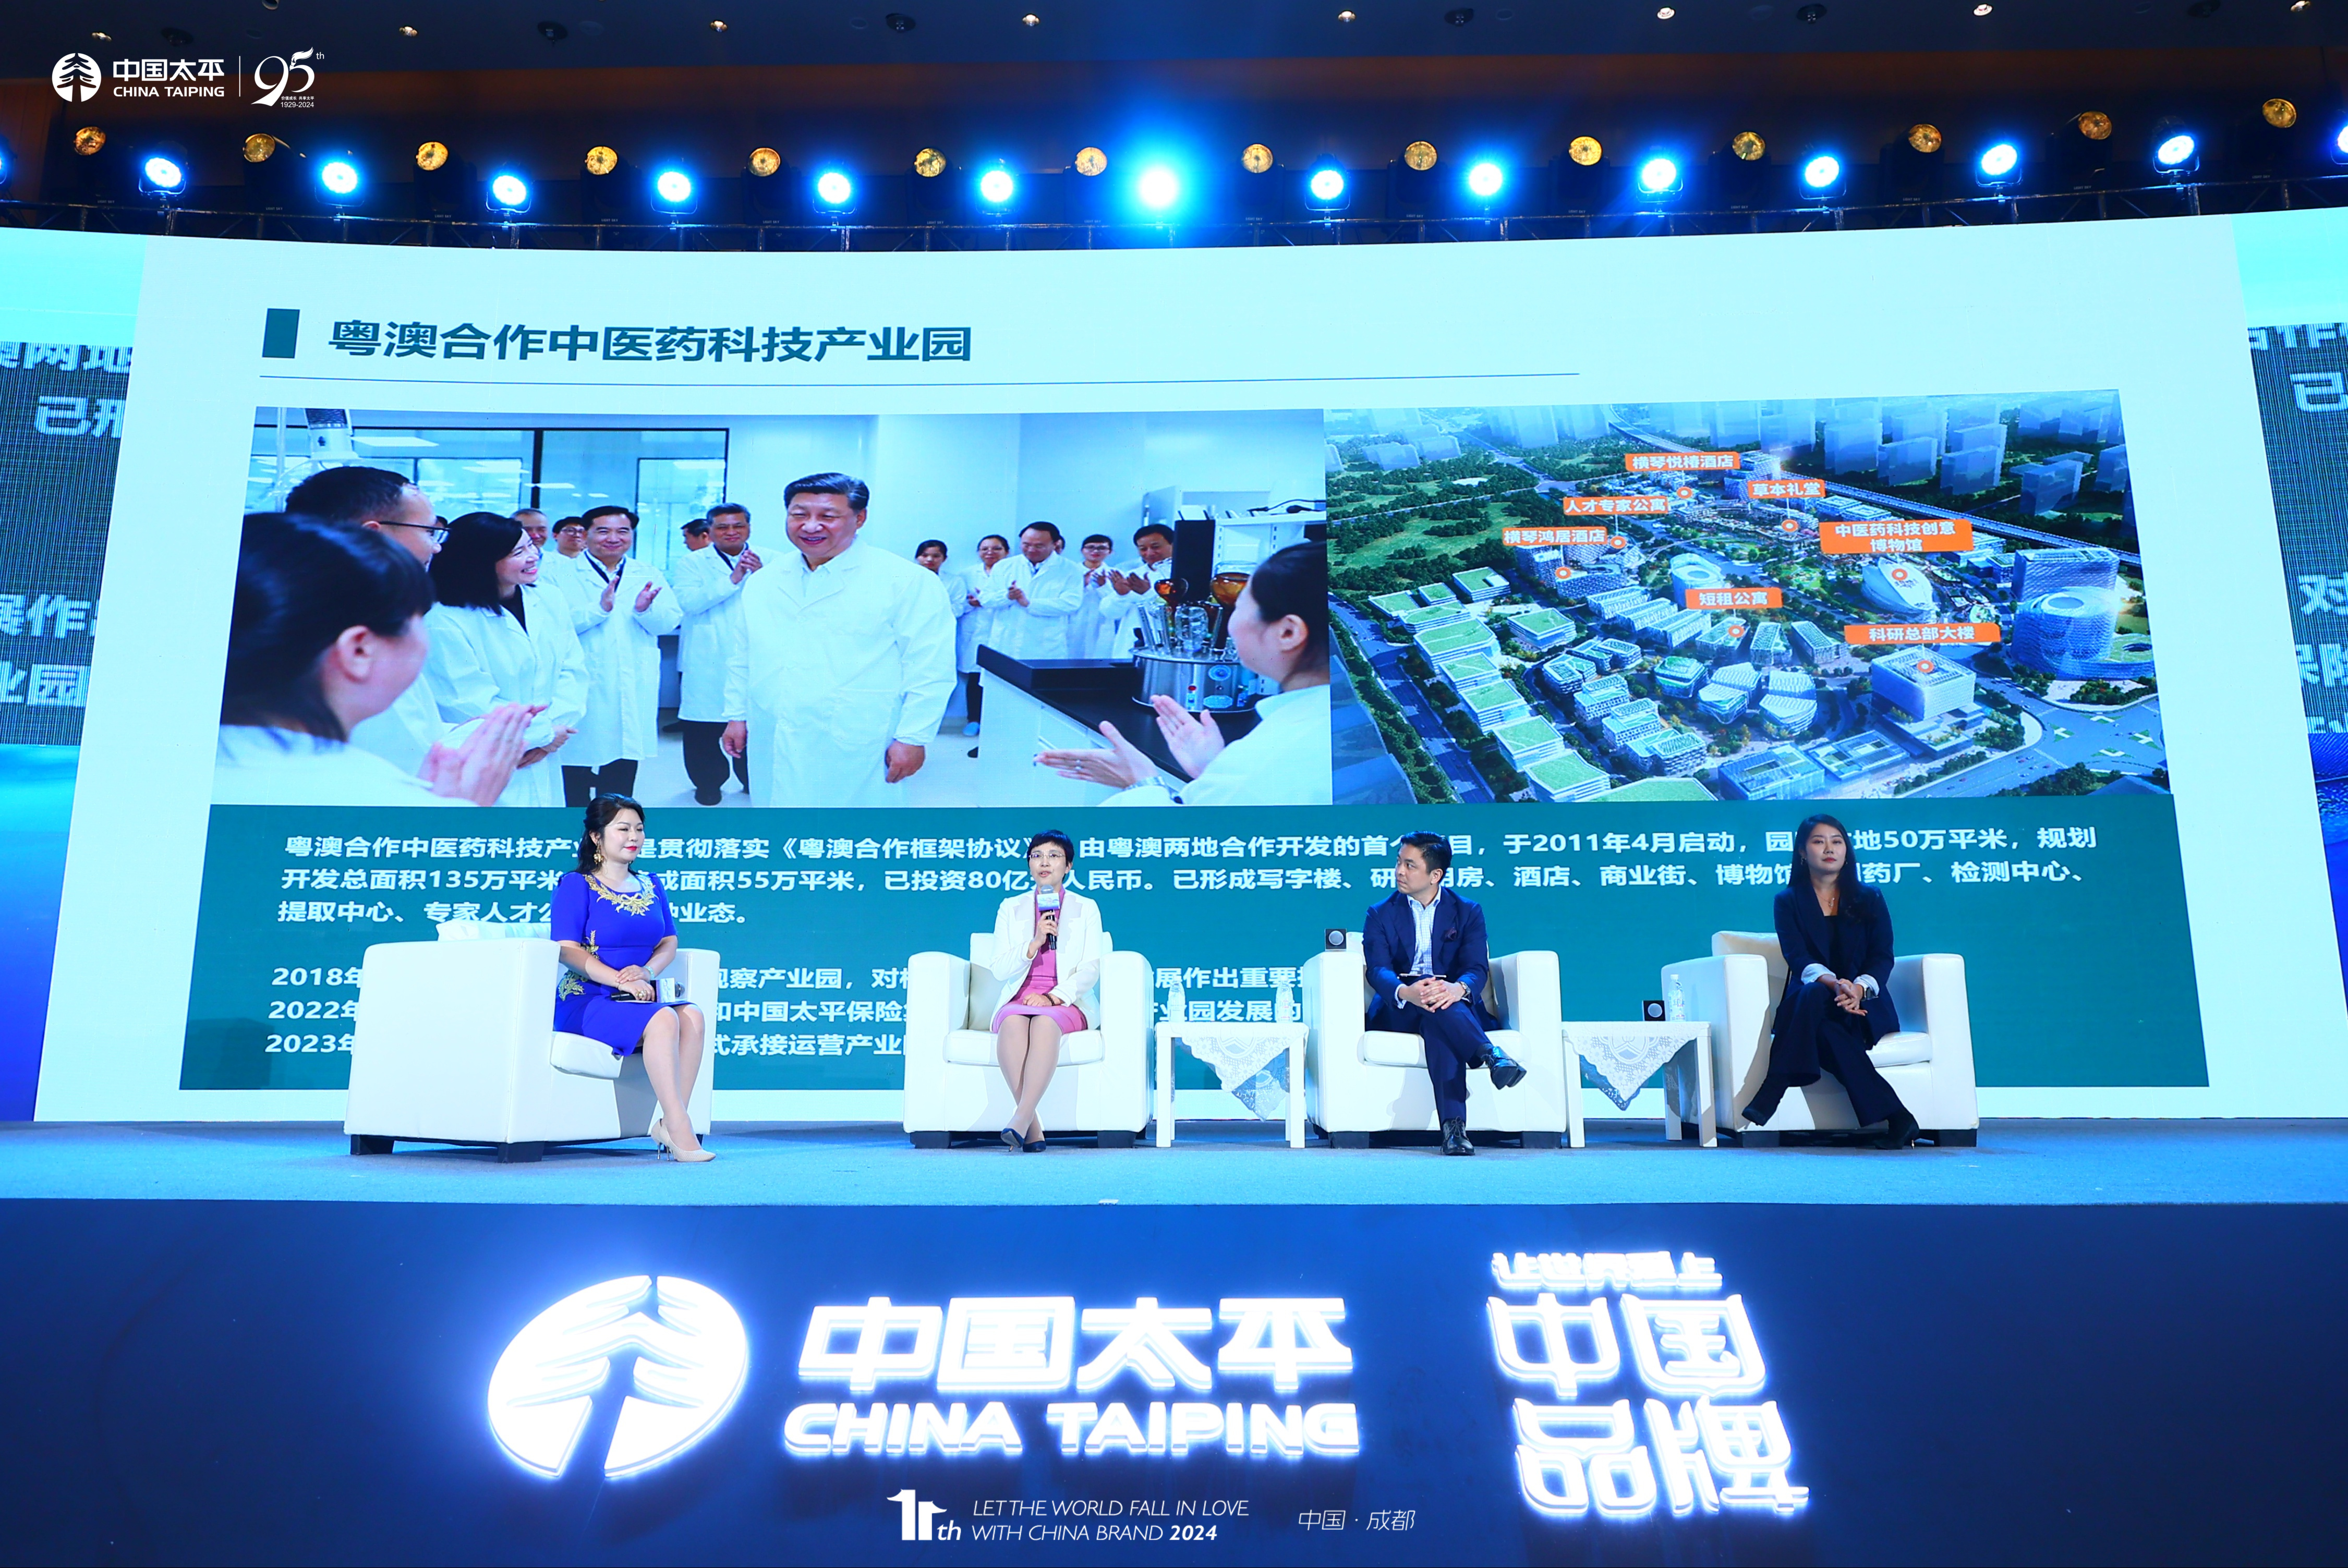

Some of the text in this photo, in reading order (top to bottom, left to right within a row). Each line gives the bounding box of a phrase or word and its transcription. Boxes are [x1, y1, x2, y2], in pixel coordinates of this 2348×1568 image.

[328, 319, 972, 363] 粤澳合作中医药科技产业园
[1752, 482, 1821, 496] 草本礼堂
[1565, 498, 1666, 513] 人才专家公寓
[1504, 529, 1606, 543] 横琴鸿居酒店
[1835, 521, 1955, 537] 中医药科技创意
[1870, 538, 1923, 552] 博物馆
[1699, 591, 1768, 606] 短租公寓
[1869, 626, 1975, 641] 科研总部大楼
[797, 1296, 1354, 1392] 中国太平
[1485, 1292, 1767, 1399] 中国
[783, 1401, 1361, 1456] CHINA TAIPING
[1511, 1394, 1811, 1515] 品牌
